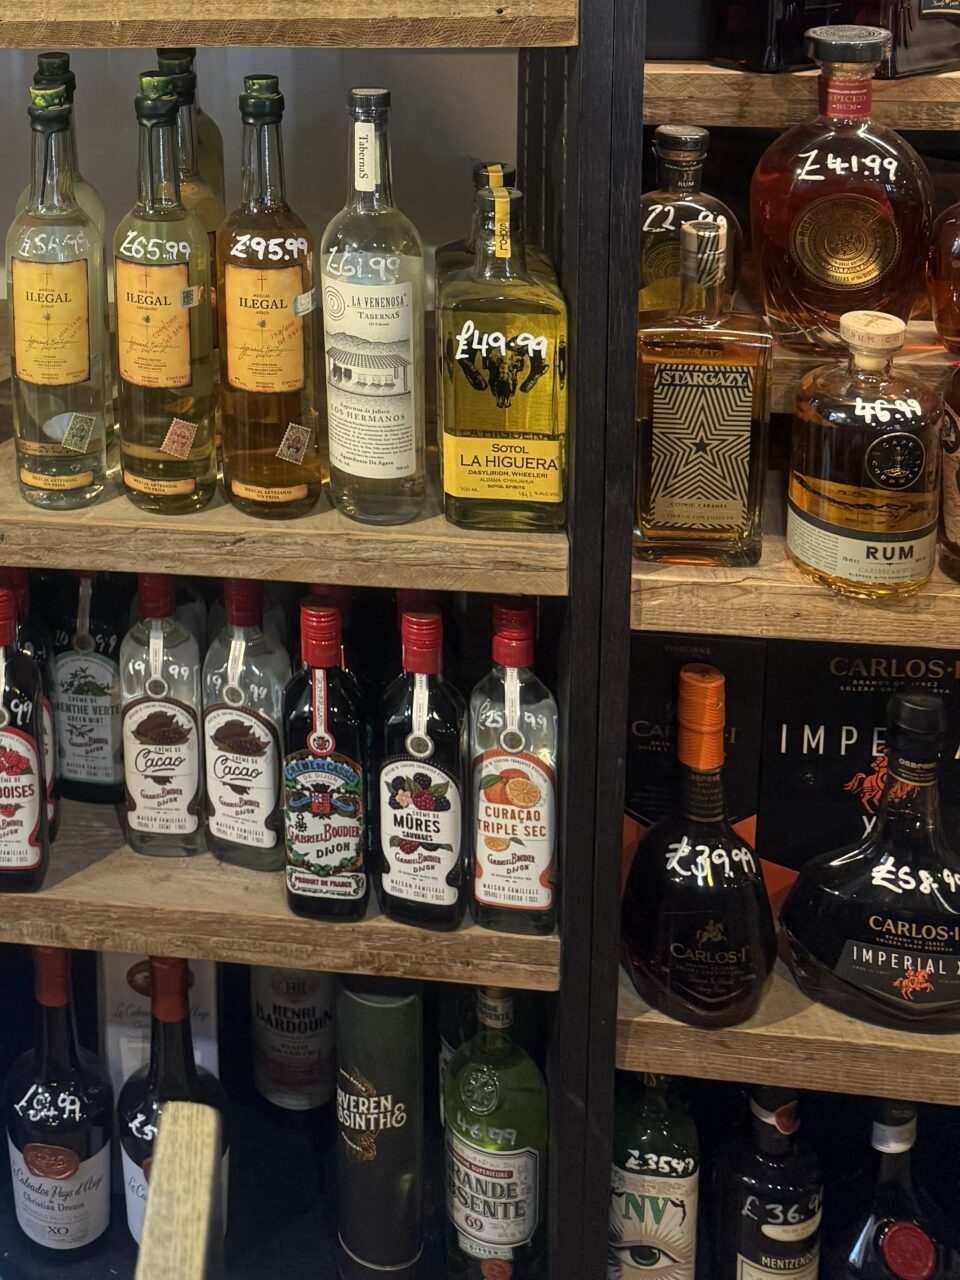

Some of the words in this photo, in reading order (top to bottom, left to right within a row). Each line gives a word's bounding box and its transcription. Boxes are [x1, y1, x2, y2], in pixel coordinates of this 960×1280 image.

[797, 150, 898, 181] £41.99
[499, 223, 508, 251] SOTOL
[120, 230, 191, 261] £65.99
[230, 234, 308, 261] £95.99
[25, 292, 72, 303] ILEGAL
[126, 291, 171, 306] ILEGAL
[239, 297, 288, 309] ILEGAL
[352, 295, 362, 308] LA
[365, 294, 405, 308] VENENOSA
[454, 319, 549, 360] £49.99
[662, 371, 745, 386] STARGAZY
[347, 412, 406, 423] HERMANOS
[491, 443, 529, 454] SOTOL
[460, 455, 482, 467] LA
[485, 456, 559, 471] HIGUERA
[512, 471, 549, 479] WHEELERI
[866, 544, 914, 561] RUM
[135, 748, 186, 769] Cacao
[214, 754, 263, 778] Cacao
[393, 813, 441, 833] MÛRES
[485, 805, 541, 825] CURAÇAO
[402, 831, 433, 841] SAUVAGES
[477, 819, 518, 835] TRIPLE
[524, 825, 547, 838] SEC
[316, 842, 350, 858] DIJON
[294, 876, 320, 886] PRODUIT
[329, 878, 352, 887] FRANCE
[853, 945, 946, 975] IMPERIAL
[272, 1005, 317, 1019] HENRI
[47, 1225, 69, 1235] XO
[465, 1214, 483, 1232] 69
